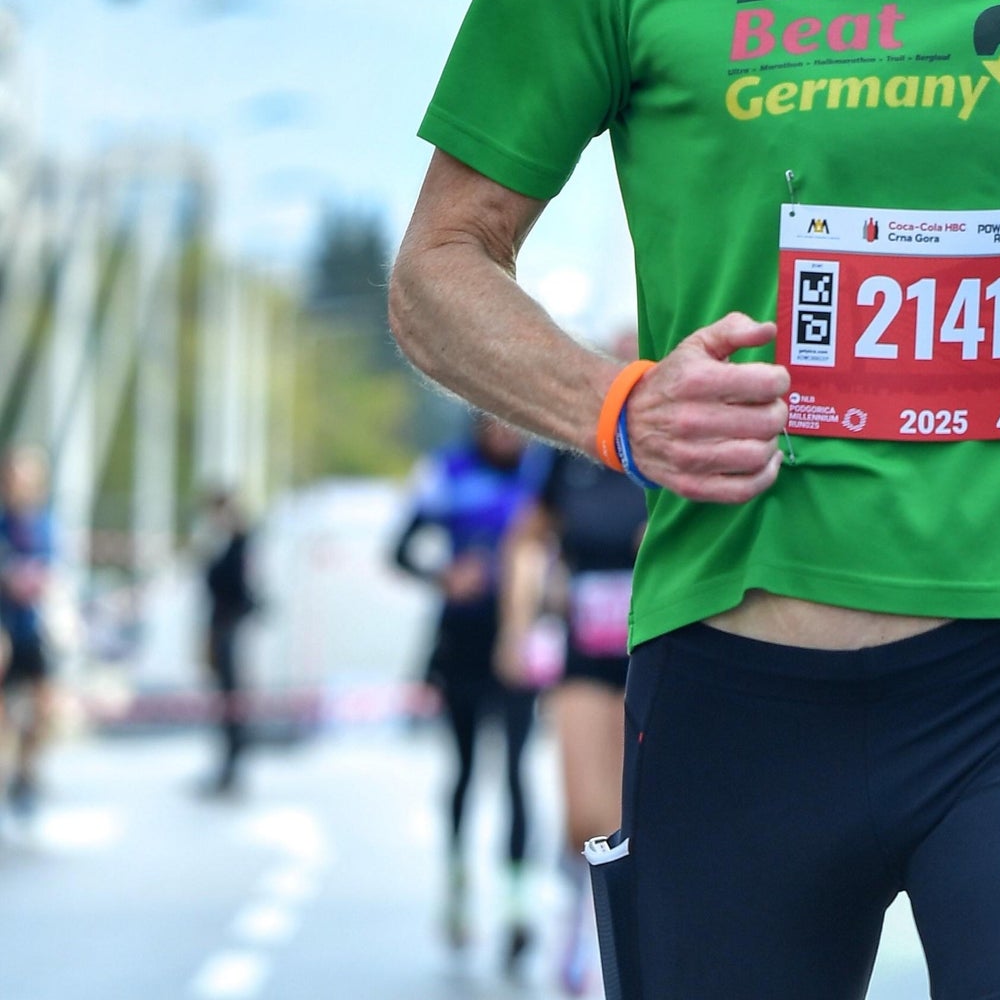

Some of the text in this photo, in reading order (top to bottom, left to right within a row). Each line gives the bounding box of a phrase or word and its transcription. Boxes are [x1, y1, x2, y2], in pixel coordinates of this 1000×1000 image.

[730, 3, 905, 62] Beat
[725, 74, 990, 121] Germany
[888, 221, 966, 233] Coca-Cola HBC
[888, 233, 939, 243] Crna Gora
[900, 409, 969, 434] 2025
